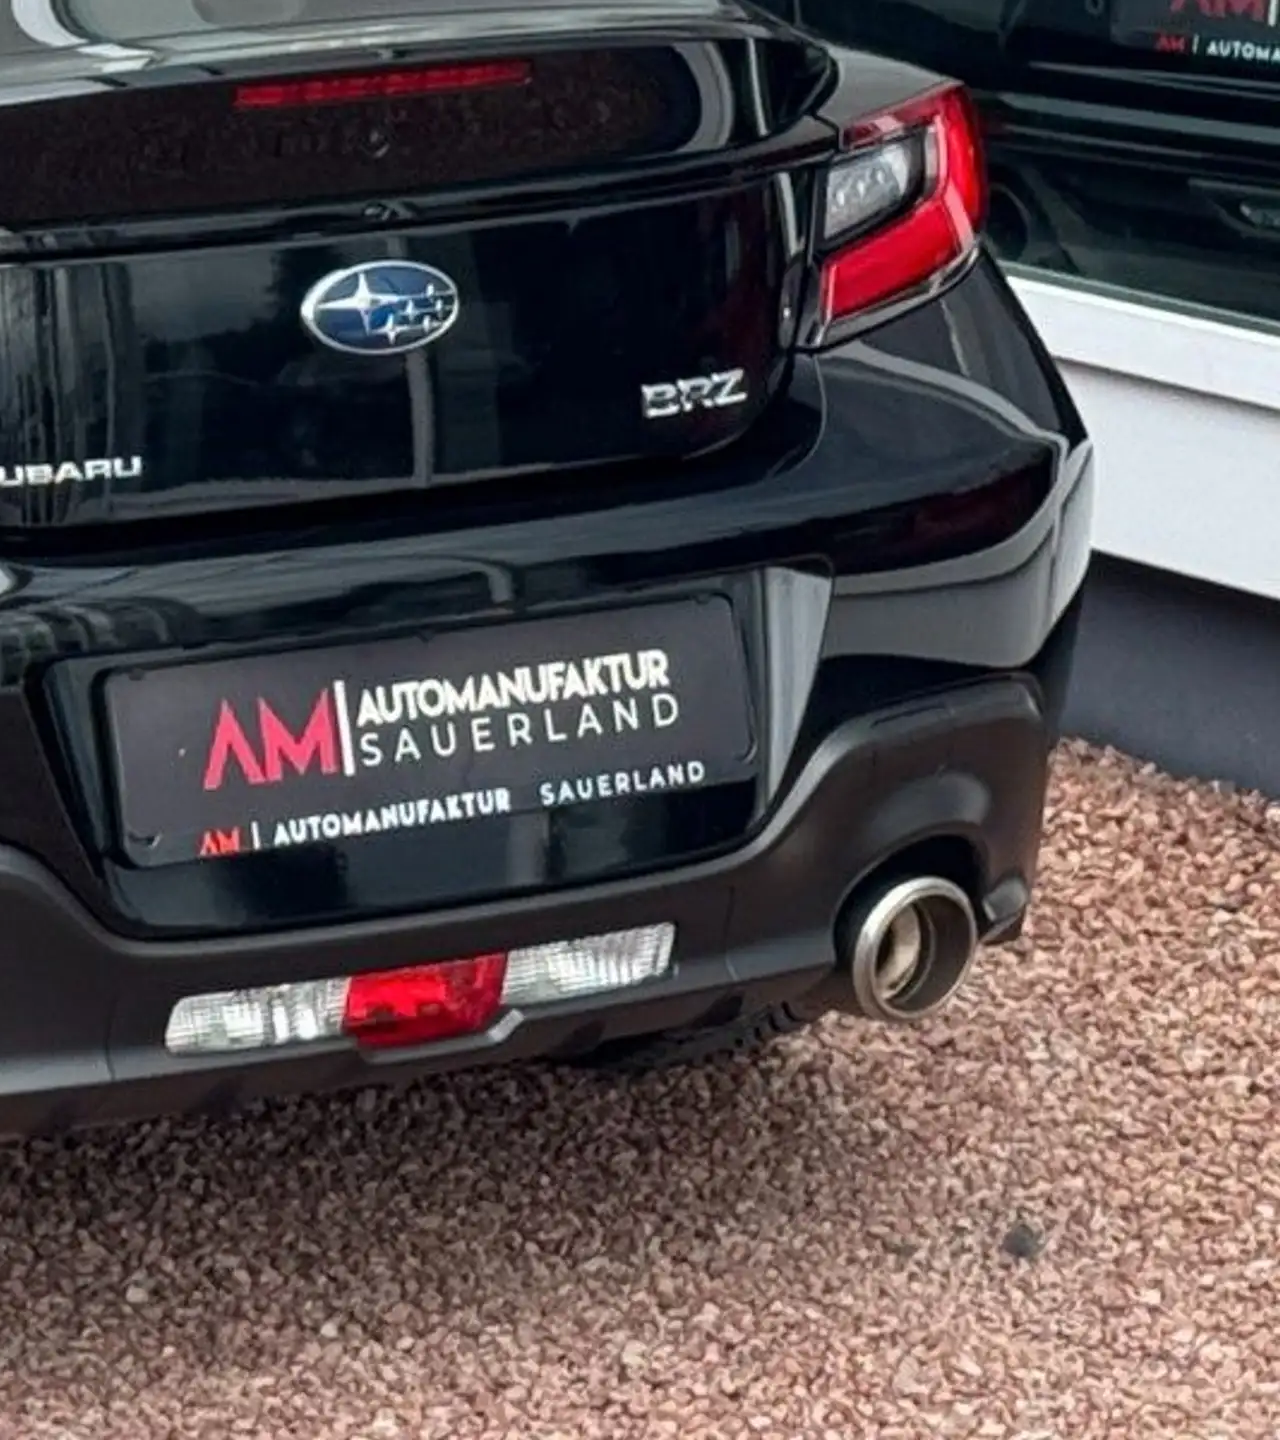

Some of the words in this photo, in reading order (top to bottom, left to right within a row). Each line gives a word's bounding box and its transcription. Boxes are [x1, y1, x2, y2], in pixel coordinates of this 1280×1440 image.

[640, 366, 748, 419] BRZ
[202, 687, 338, 791] AM
[356, 649, 671, 728] AUTOMANUFAKTUR
[359, 692, 680, 768] SAUERLAND
[199, 826, 241, 857] AM
[273, 786, 512, 847] AUTOMANUFAKTUR
[538, 759, 705, 807] SAUERLAND
